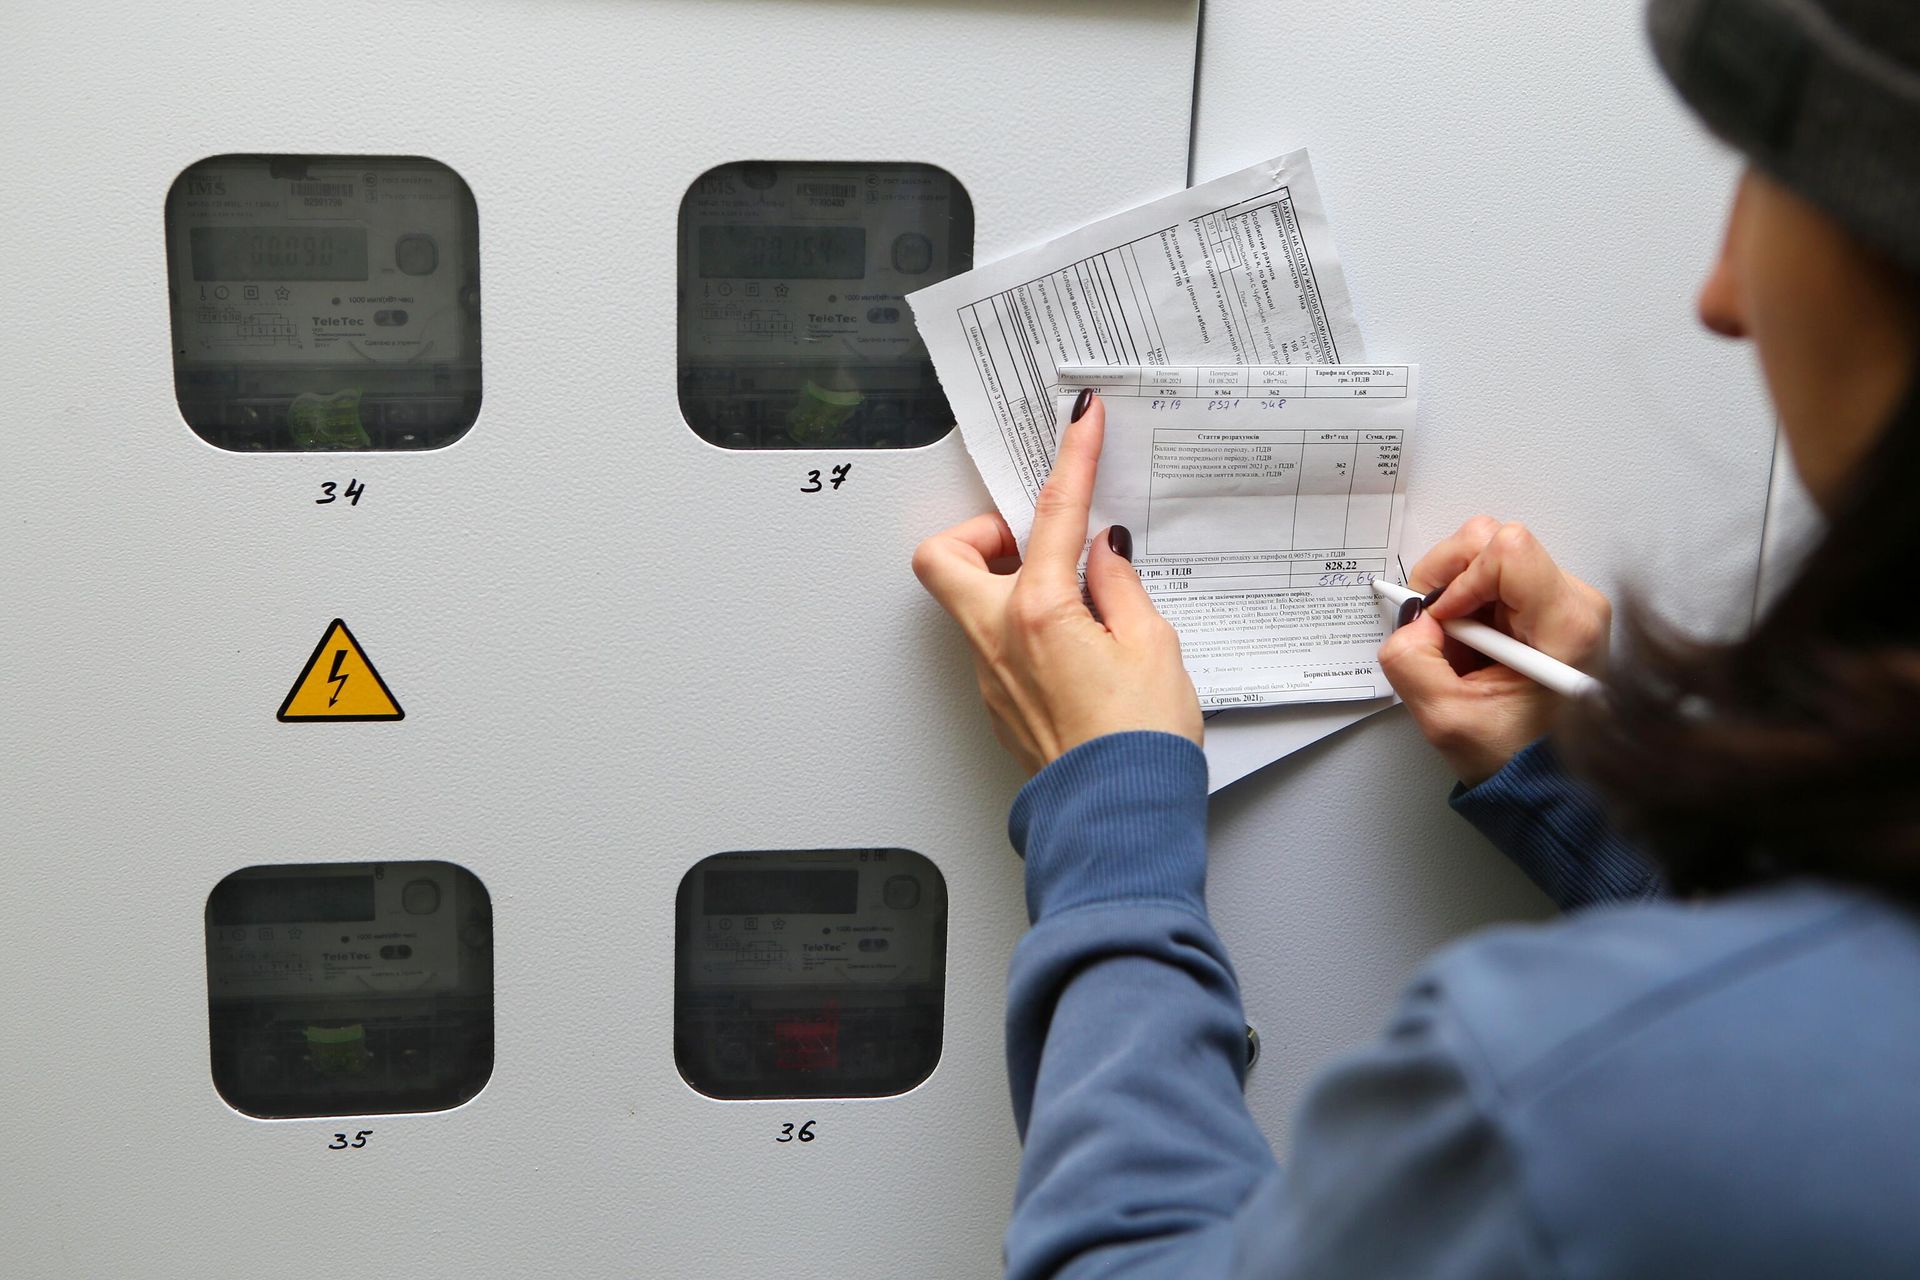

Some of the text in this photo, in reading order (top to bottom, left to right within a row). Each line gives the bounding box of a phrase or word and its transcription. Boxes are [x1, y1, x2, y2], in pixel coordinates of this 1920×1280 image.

[1280, 200, 1295, 234] РАХУНОК
[1249, 210, 1267, 251] Особистий
[1261, 250, 1276, 280] рахунок
[1269, 203, 1285, 238] Приватне
[1279, 238, 1300, 289] підприємство
[1291, 234, 1299, 246] НА
[1159, 231, 1182, 287] Вивезення ТПВ
[1239, 213, 1276, 310] Прізвище, по батькові
[1294, 246, 1309, 278] СПЛАТУ
[1168, 227, 1211, 345] Разовий платіж (ремонт кабелю)
[1192, 219, 1239, 353] Утримання будинку та прибудинкової
[312, 317, 364, 326] TeleTec
[808, 314, 857, 323] TeleTec
[1016, 286, 1041, 345] Водовідведення
[1036, 278, 1069, 363] Гаряче водопостачання
[1060, 269, 1096, 360] Холодне водопостачання
[1298, 335, 1308, 350] ПАТ
[969, 325, 985, 357] Шановні
[1006, 426, 1024, 466] погашення
[1020, 465, 1034, 487] боргу
[1018, 399, 1047, 469] Прохання сплатити
[1020, 431, 1035, 459] пізніше
[316, 478, 366, 506] 34
[800, 462, 852, 494] 37
[1171, 568, 1192, 576] ПДВ
[1261, 554, 1287, 562] тарифом
[1169, 582, 1189, 590] ПДВ
[1303, 670, 1353, 678] Бориспільське
[1211, 695, 1242, 704] Серпень
[328, 1130, 374, 1150] 35
[775, 1119, 817, 1143] 36
